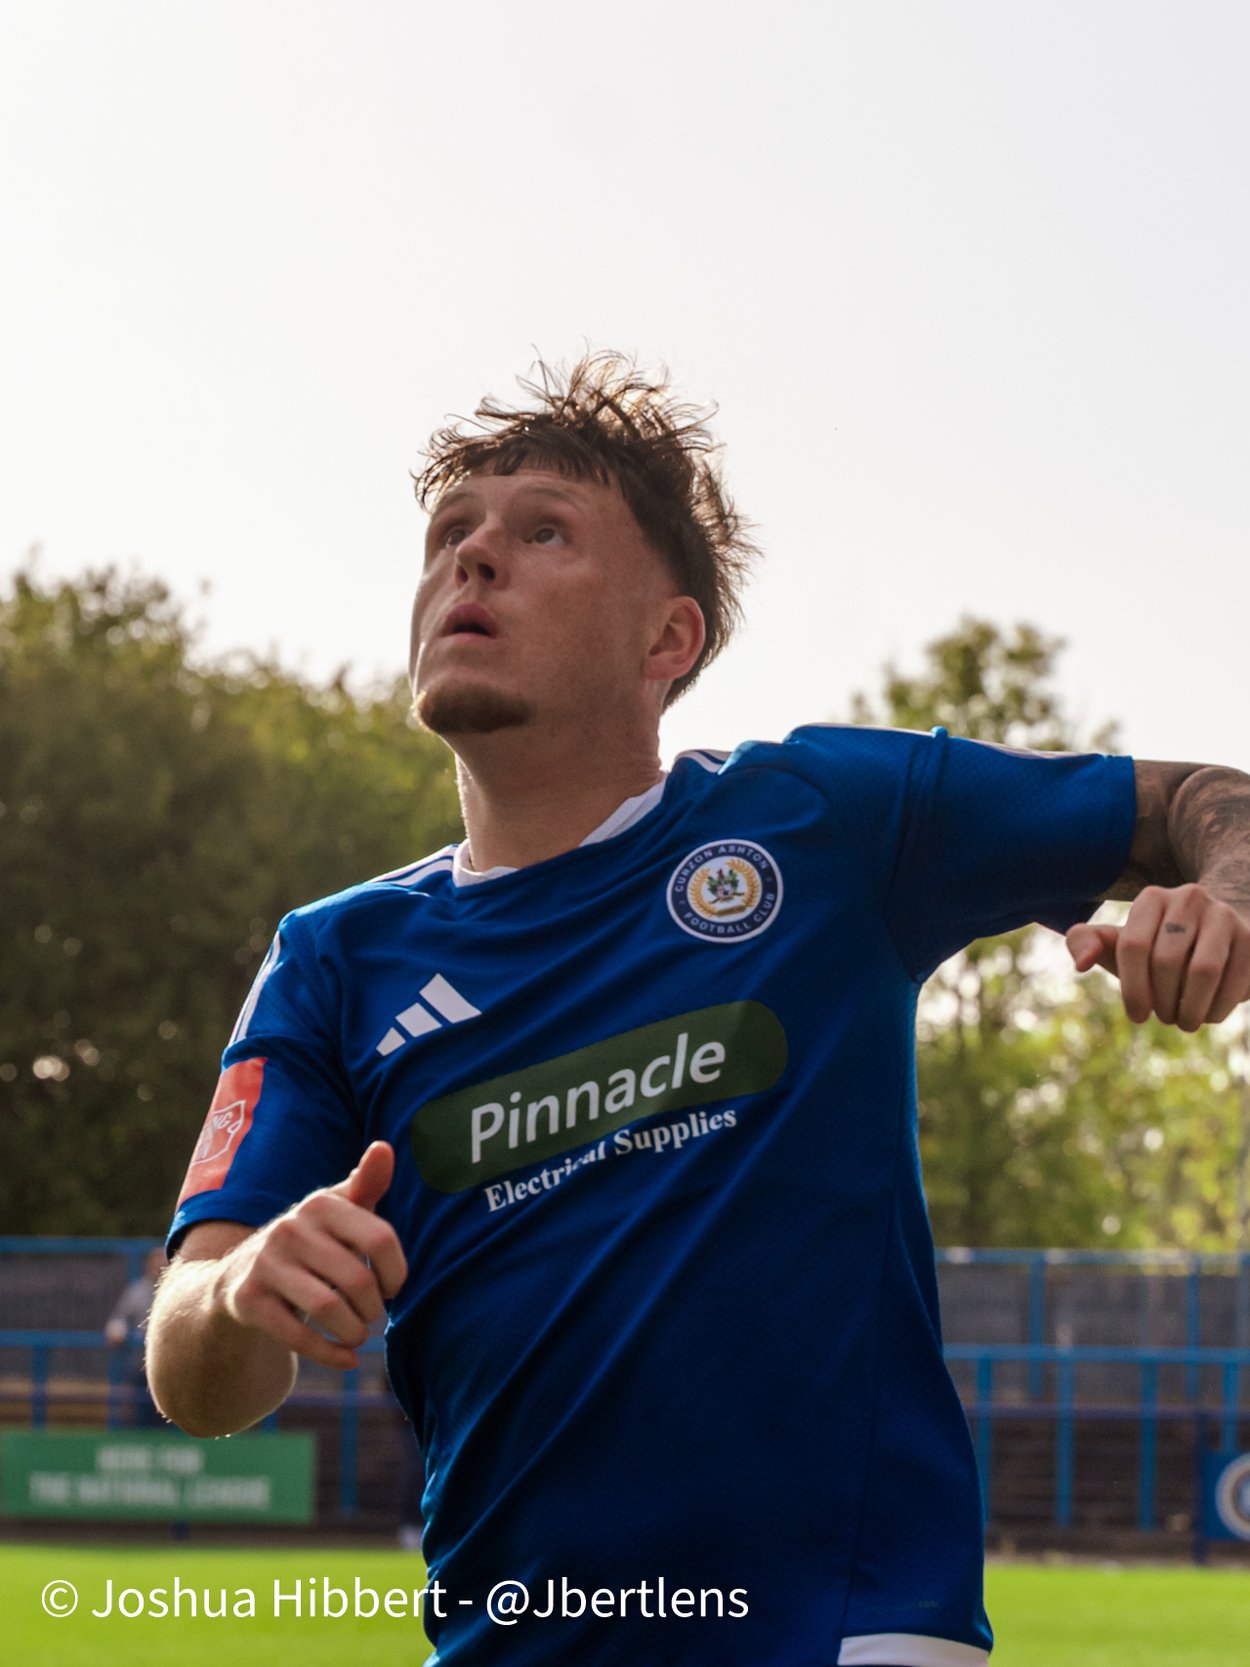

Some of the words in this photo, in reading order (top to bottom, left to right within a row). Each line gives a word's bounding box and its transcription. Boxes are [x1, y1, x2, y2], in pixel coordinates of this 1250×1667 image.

[674, 850, 713, 893] CURZON
[718, 845, 769, 870] ASHTON
[684, 912, 752, 935] FOOTBALL
[753, 893, 776, 923] CLUB
[470, 1032, 726, 1165] Pinnacle
[613, 1108, 737, 1157] Supplies
